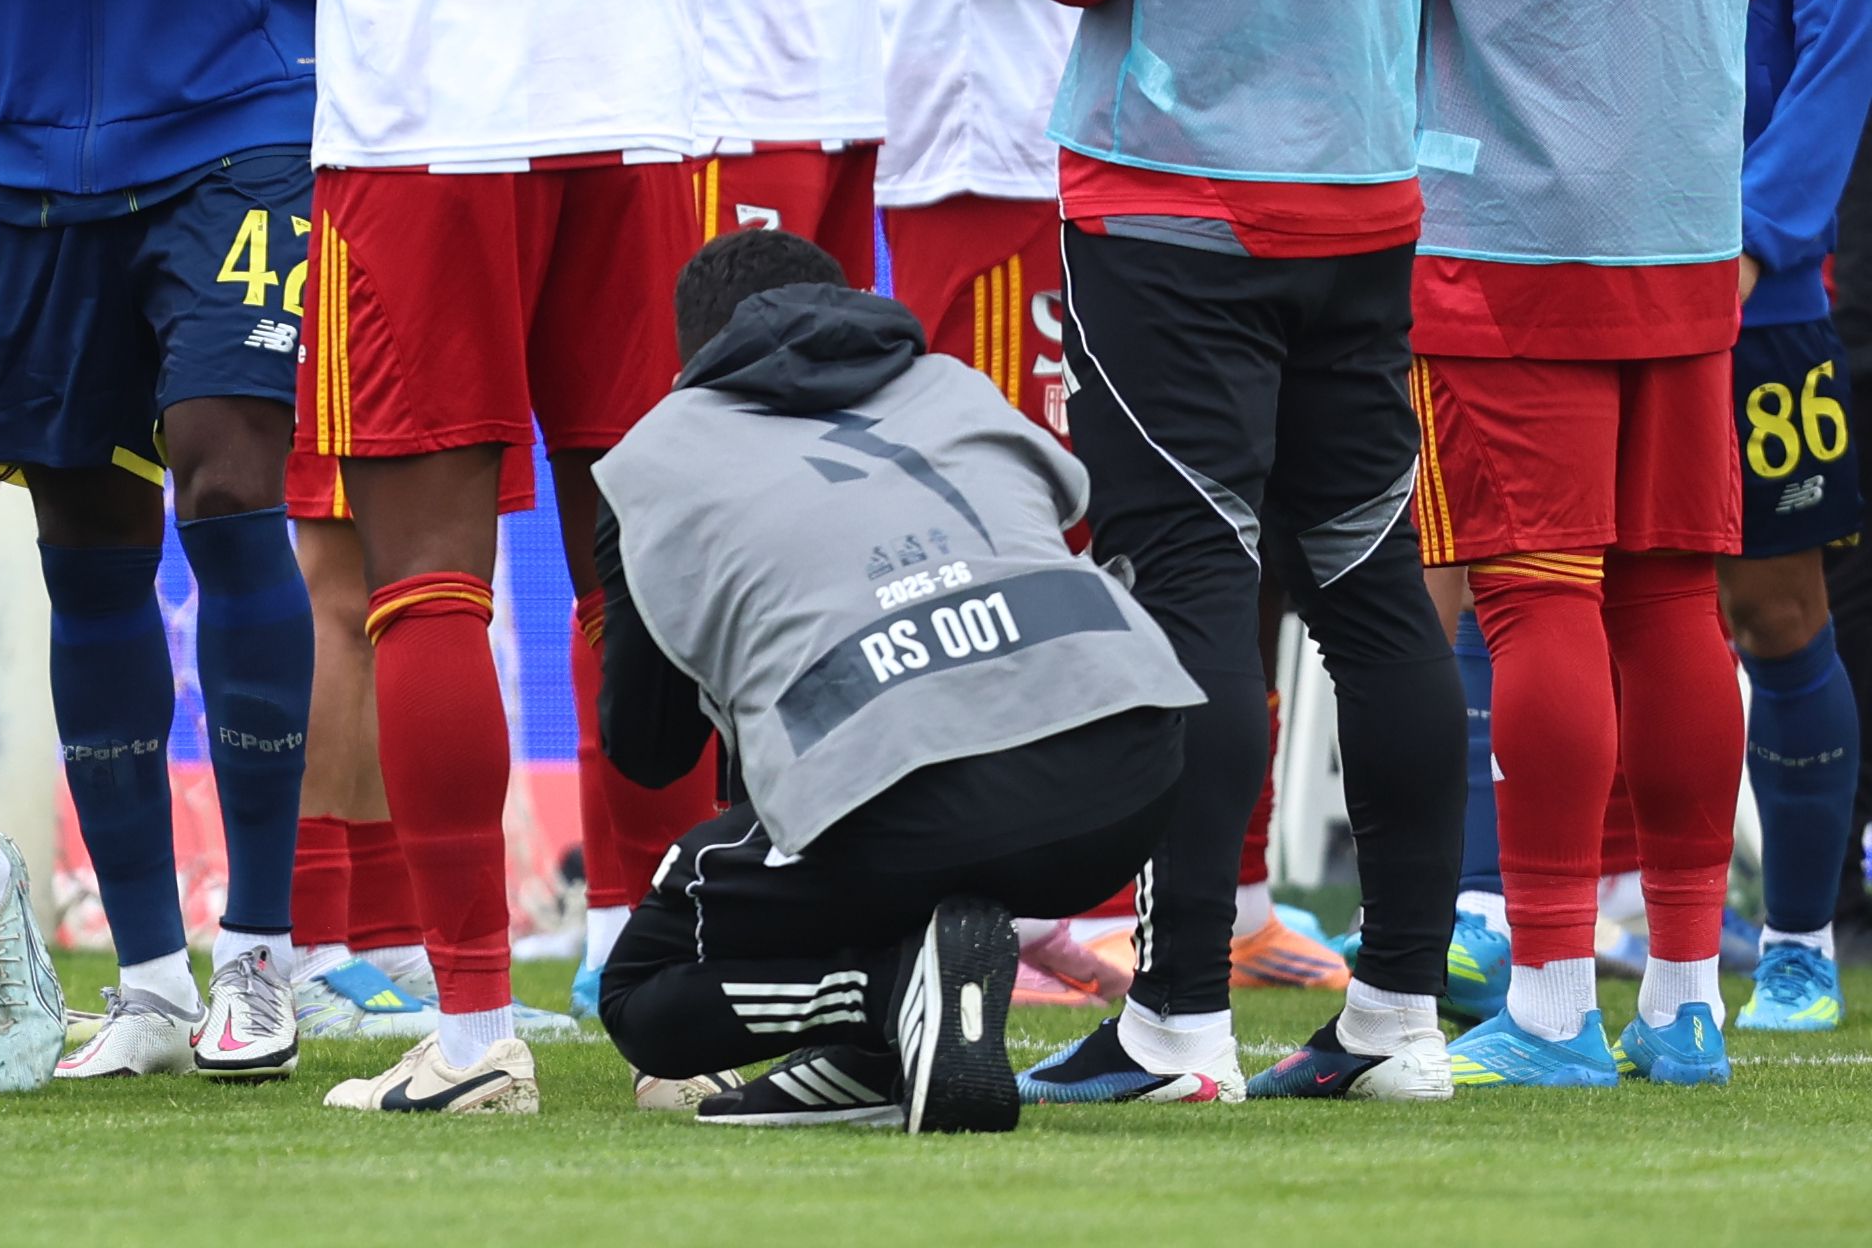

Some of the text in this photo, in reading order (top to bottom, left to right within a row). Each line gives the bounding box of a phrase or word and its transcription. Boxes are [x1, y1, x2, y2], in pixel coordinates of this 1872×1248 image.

[1746, 360, 1849, 478] 86
[875, 560, 972, 610] 2025-26
[859, 591, 1021, 683] RS 001
